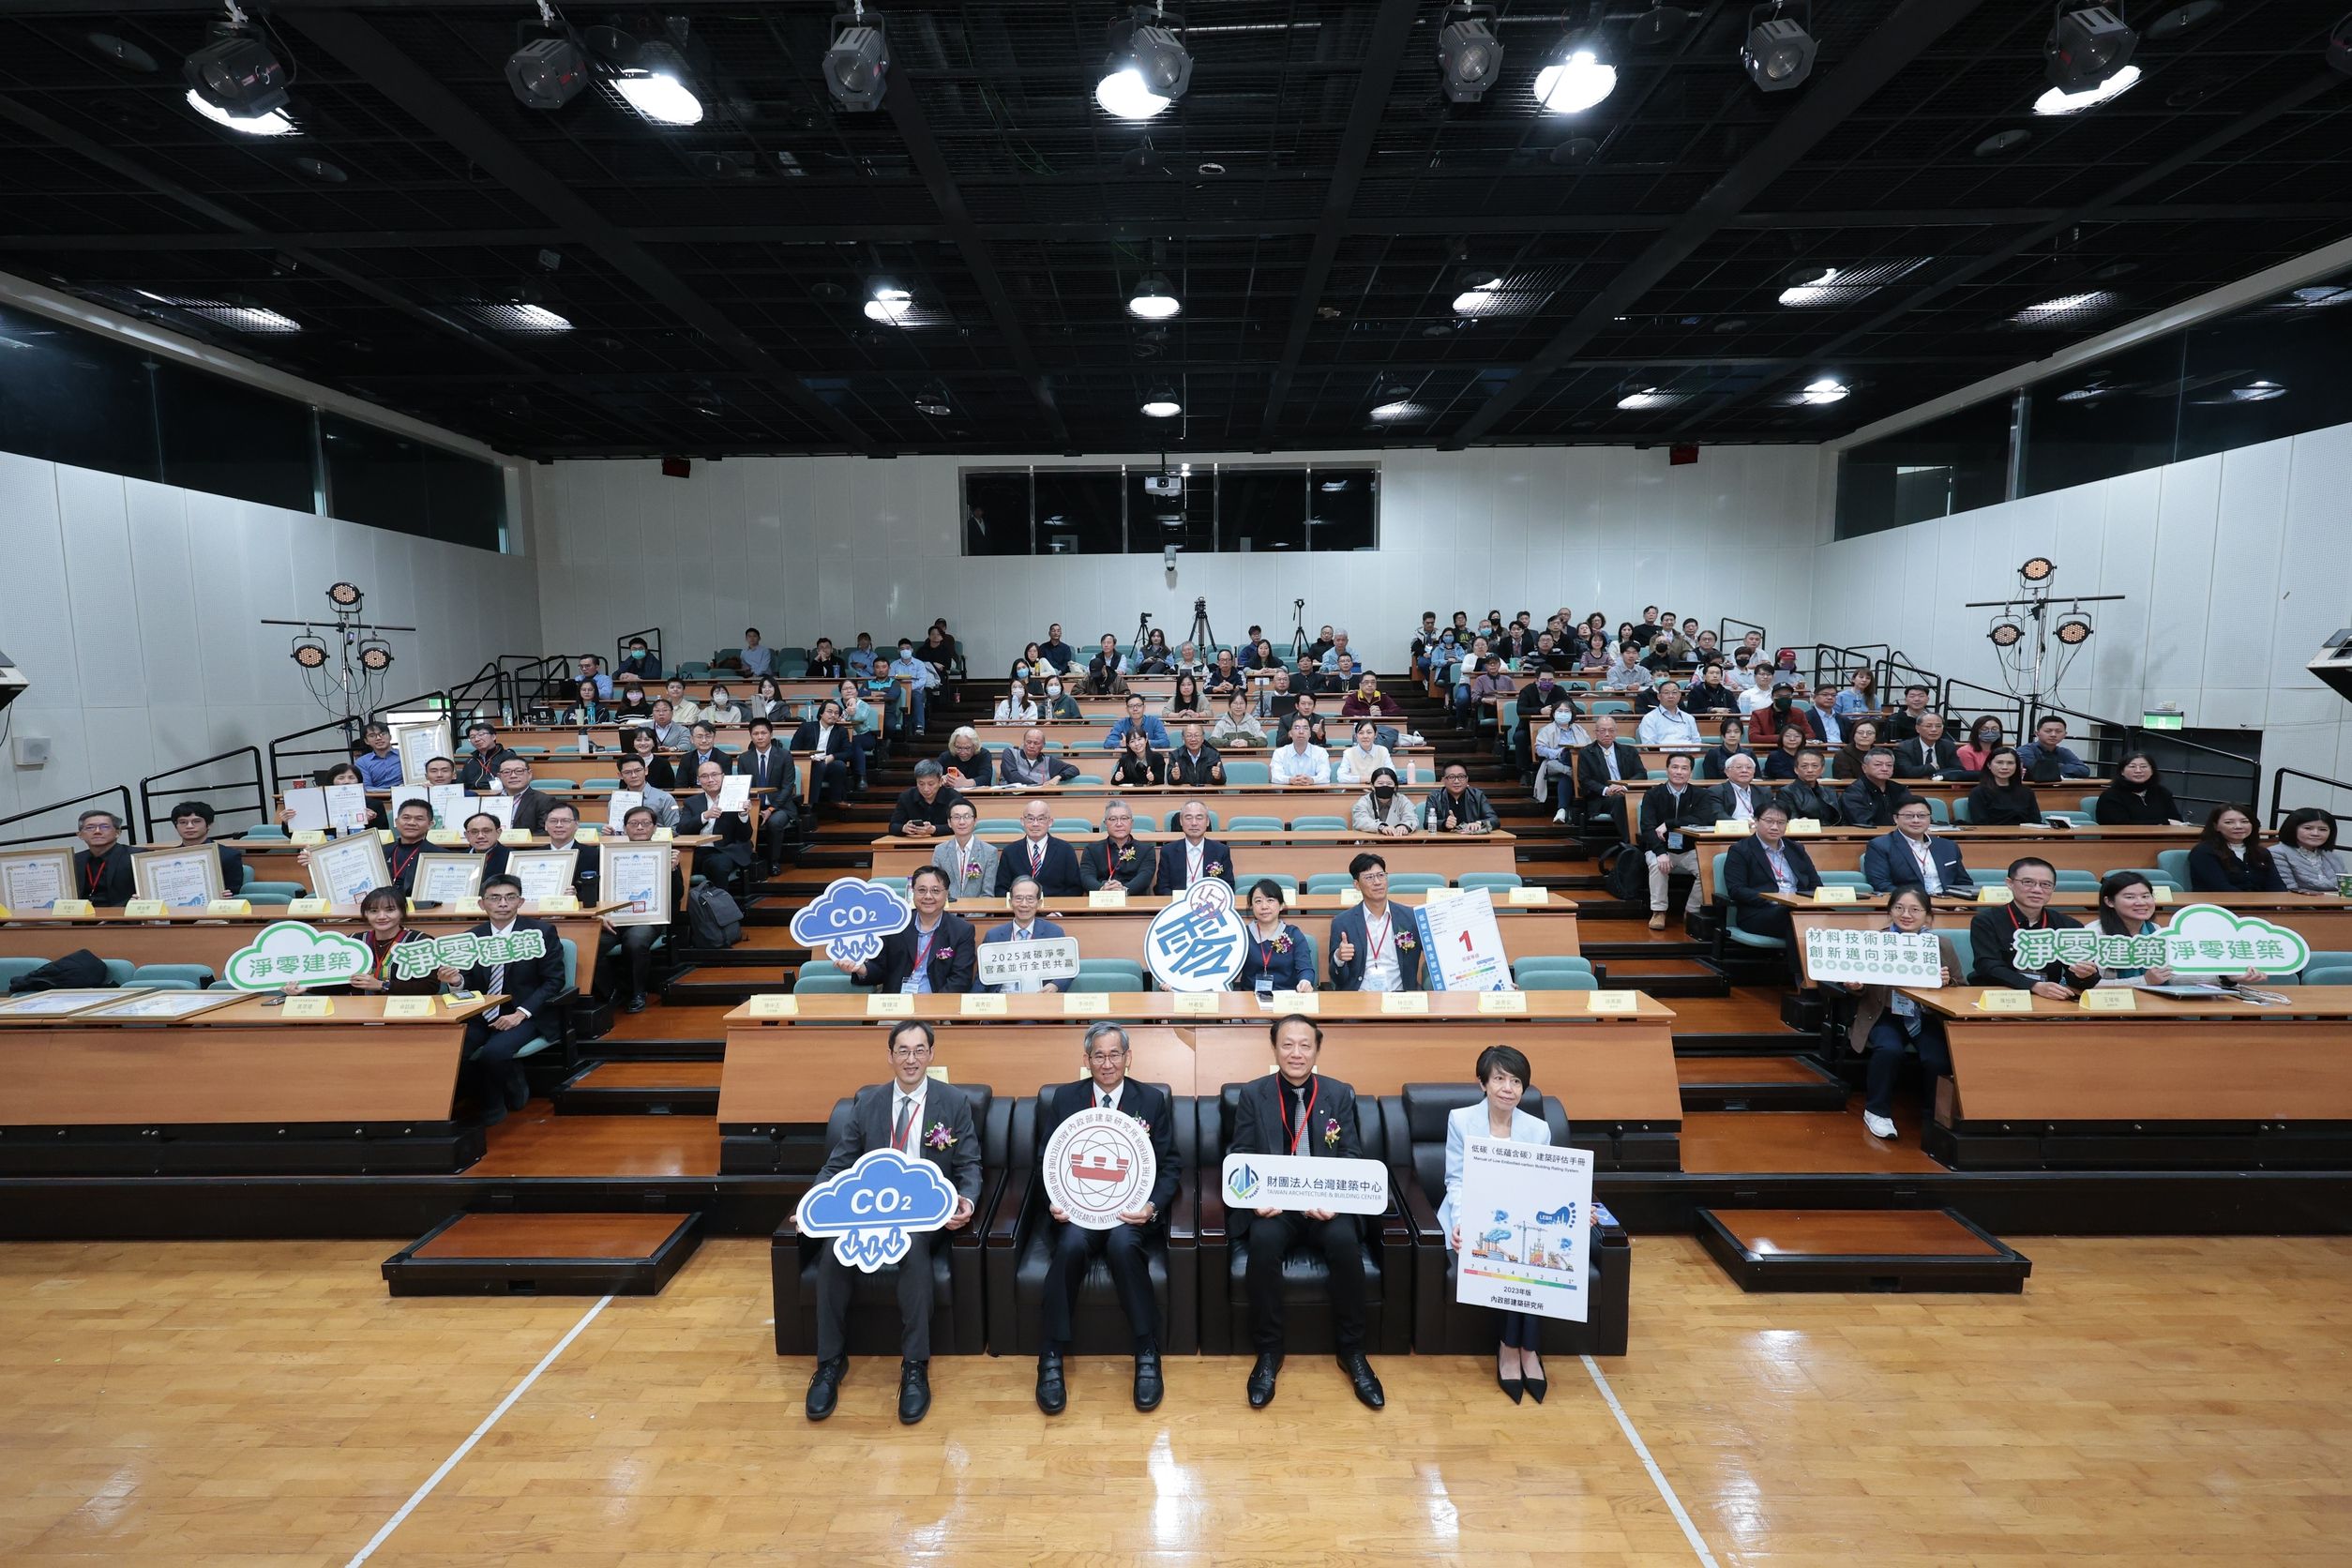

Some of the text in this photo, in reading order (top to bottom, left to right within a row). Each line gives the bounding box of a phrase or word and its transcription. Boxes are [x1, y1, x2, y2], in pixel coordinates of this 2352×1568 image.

[830, 905, 878, 928] CO2
[1458, 929, 1473, 952] 1
[1808, 928, 1937, 949] 材料技術與工法
[2017, 929, 2167, 969] 淨零建築
[2171, 939, 2284, 960] 淨零建築
[249, 951, 353, 979] 淨零建築
[397, 931, 545, 979] 淨零建築
[1809, 945, 1938, 964] 創新邁向淨零路
[1049, 1130, 1069, 1169] ARCHITECTURE
[1135, 1138, 1150, 1165] INTERIOR
[1048, 1171, 1057, 1184] AND
[1141, 1179, 1149, 1187] OF
[1142, 1166, 1151, 1178] THE
[1267, 1175, 1383, 1194] 財團法人台灣建築中心
[1288, 1189, 1329, 1199] ARCHITECTURE
[1334, 1192, 1360, 1200] BUILDING
[1360, 1193, 1381, 1201] CENTER
[851, 1187, 912, 1214] CO2
[1051, 1185, 1070, 1211] BUILDING
[1125, 1189, 1146, 1212] MINISTRY
[1070, 1207, 1096, 1224] RESEARCH
